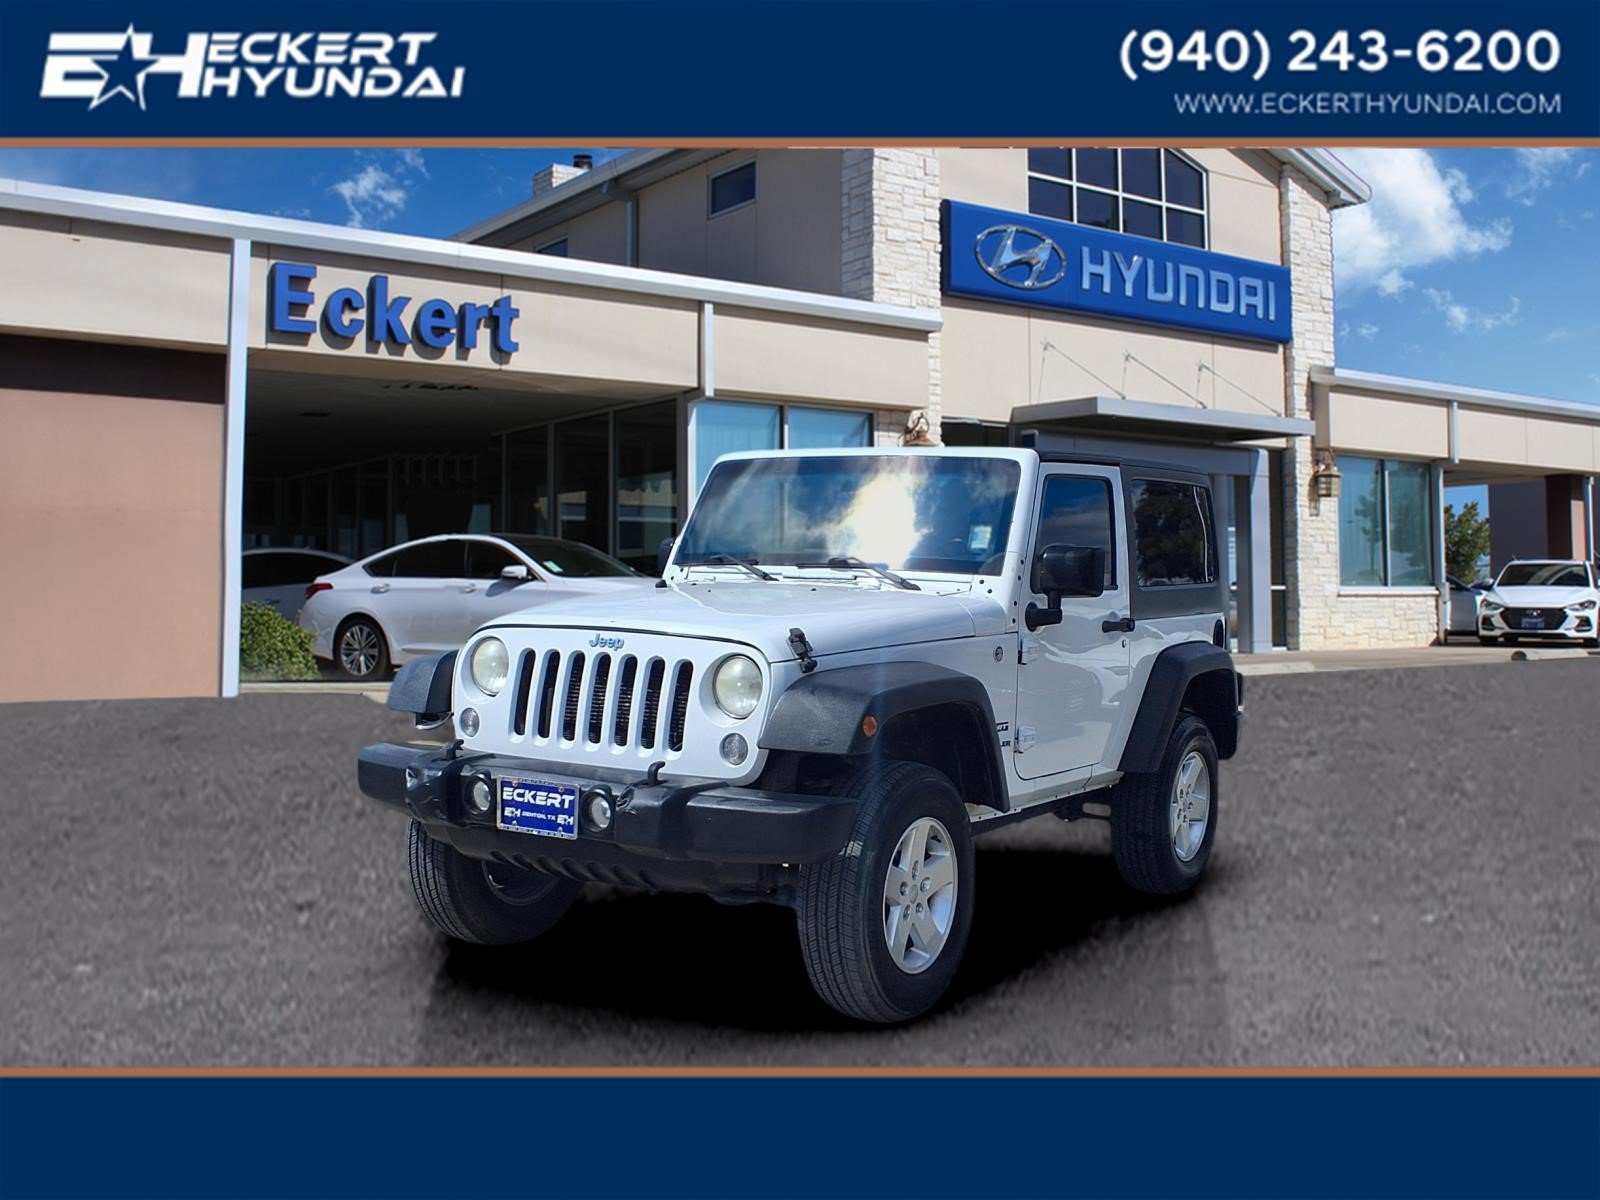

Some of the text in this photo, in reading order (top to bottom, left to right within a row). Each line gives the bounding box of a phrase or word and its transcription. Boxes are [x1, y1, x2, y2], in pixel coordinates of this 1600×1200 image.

[1080, 245, 1276, 321] HYUNDAI
[270, 262, 520, 355] Eckert
[589, 633, 625, 651] Jeep
[502, 787, 575, 809] ECKERT
